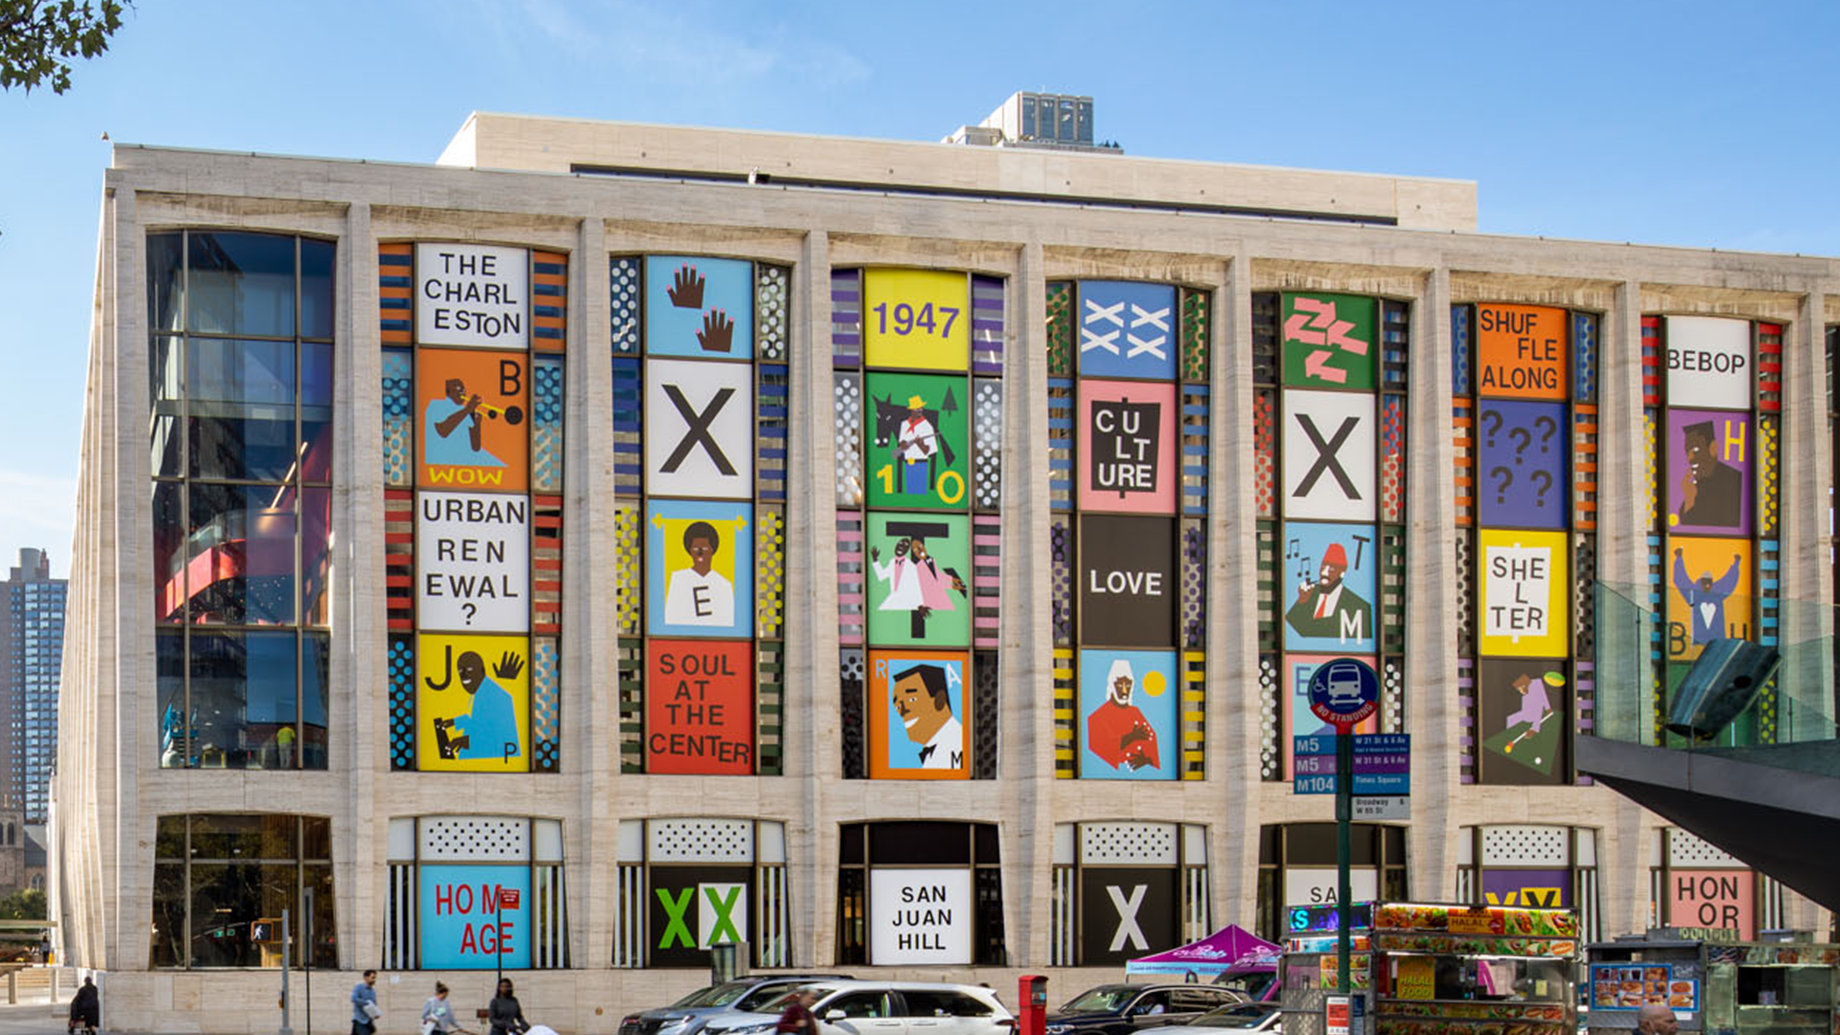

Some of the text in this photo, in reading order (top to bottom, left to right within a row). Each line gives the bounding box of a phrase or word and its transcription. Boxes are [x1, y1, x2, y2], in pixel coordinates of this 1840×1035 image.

[440, 253, 496, 276] THE
[425, 279, 517, 304] CHARL
[435, 309, 520, 337] ESTON
[873, 302, 959, 338] 1947
[1481, 309, 1537, 334] SHUF
[1518, 338, 1557, 361] FLE
[1668, 349, 1745, 374] BEBOP
[500, 360, 521, 396] B
[1482, 365, 1557, 389] ALONG
[659, 384, 738, 476] X
[1096, 410, 1139, 434] CU
[1116, 436, 1150, 461] LT
[1480, 409, 1556, 464] ? ? ?
[1725, 420, 1745, 462] H
[1292, 413, 1362, 500] X
[428, 467, 503, 485] WOW
[1099, 464, 1151, 487] URE
[1491, 466, 1552, 507] ? ?
[424, 499, 524, 523] URBAN
[438, 539, 504, 563] REN
[1353, 535, 1370, 570] T
[1493, 556, 1544, 584] SHE
[427, 574, 518, 598] EWAL
[1091, 570, 1161, 595] LOVE
[1516, 582, 1528, 604] L
[693, 586, 712, 616] E
[462, 603, 476, 625] ?
[1491, 606, 1542, 629] TER
[1340, 608, 1362, 645] M
[1670, 620, 1687, 658] B
[425, 645, 451, 691] J
[660, 654, 735, 676] SOUL
[875, 659, 962, 689] R A
[675, 680, 709, 700] AT
[665, 704, 723, 725] THE
[1316, 704, 1373, 722] NO STANDING
[503, 742, 517, 765] P
[649, 734, 749, 764] CENTER
[1297, 737, 1319, 752] M5
[951, 750, 963, 770] M
[1297, 757, 1319, 772] M5
[1297, 777, 1335, 792] M104
[1356, 798, 1389, 806] Broadway
[436, 884, 502, 916] HOM
[902, 886, 945, 902] SAN
[1679, 877, 1737, 900] HON
[893, 909, 951, 926] JUAN
[1106, 885, 1149, 951] X
[1451, 917, 1484, 926] HALAL
[1698, 902, 1739, 928] OR
[460, 922, 514, 955] AGE
[899, 934, 946, 950] HILL
[1401, 987, 1431, 998] FOOD
